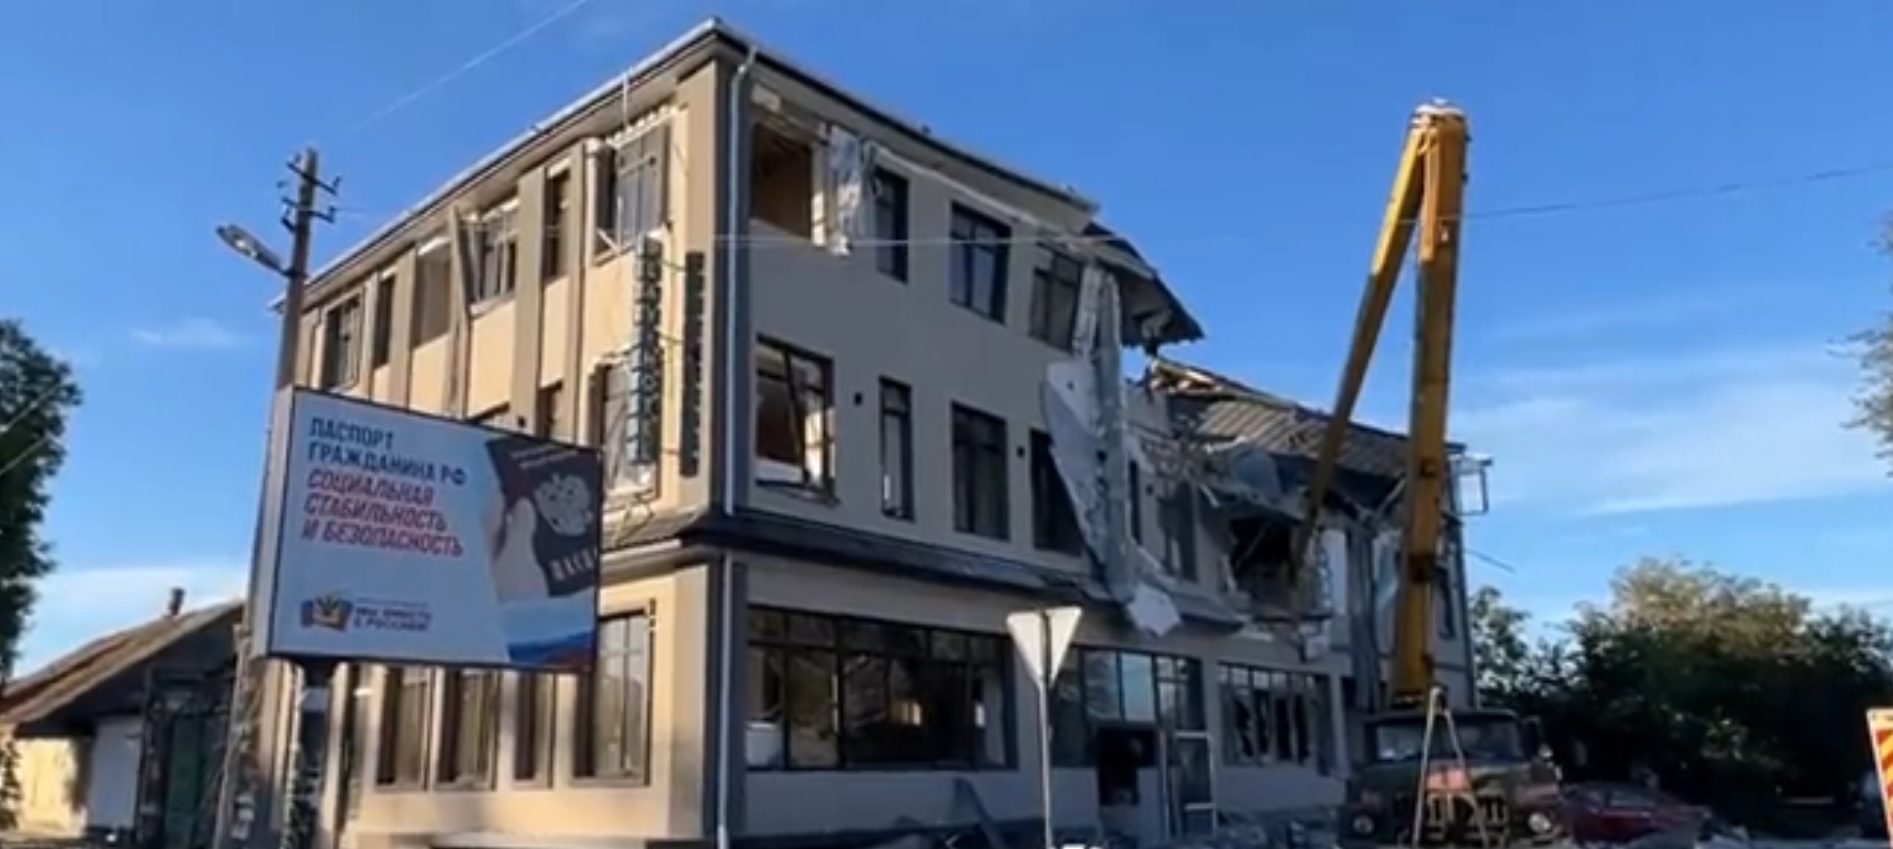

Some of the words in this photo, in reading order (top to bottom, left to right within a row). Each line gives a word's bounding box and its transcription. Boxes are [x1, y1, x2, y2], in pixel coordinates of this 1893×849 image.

[309, 417, 393, 449] ПАСПОРТ
[308, 441, 434, 481] ГРАЖДАНИНА
[440, 464, 467, 487] РФ
[307, 467, 434, 507] СОЦИАЛЬНАЯ
[304, 492, 448, 532] СТАБИЛЬНОСТЬ
[301, 518, 319, 541] И
[322, 520, 464, 558] БЕЗОПАСНОСТЬ
